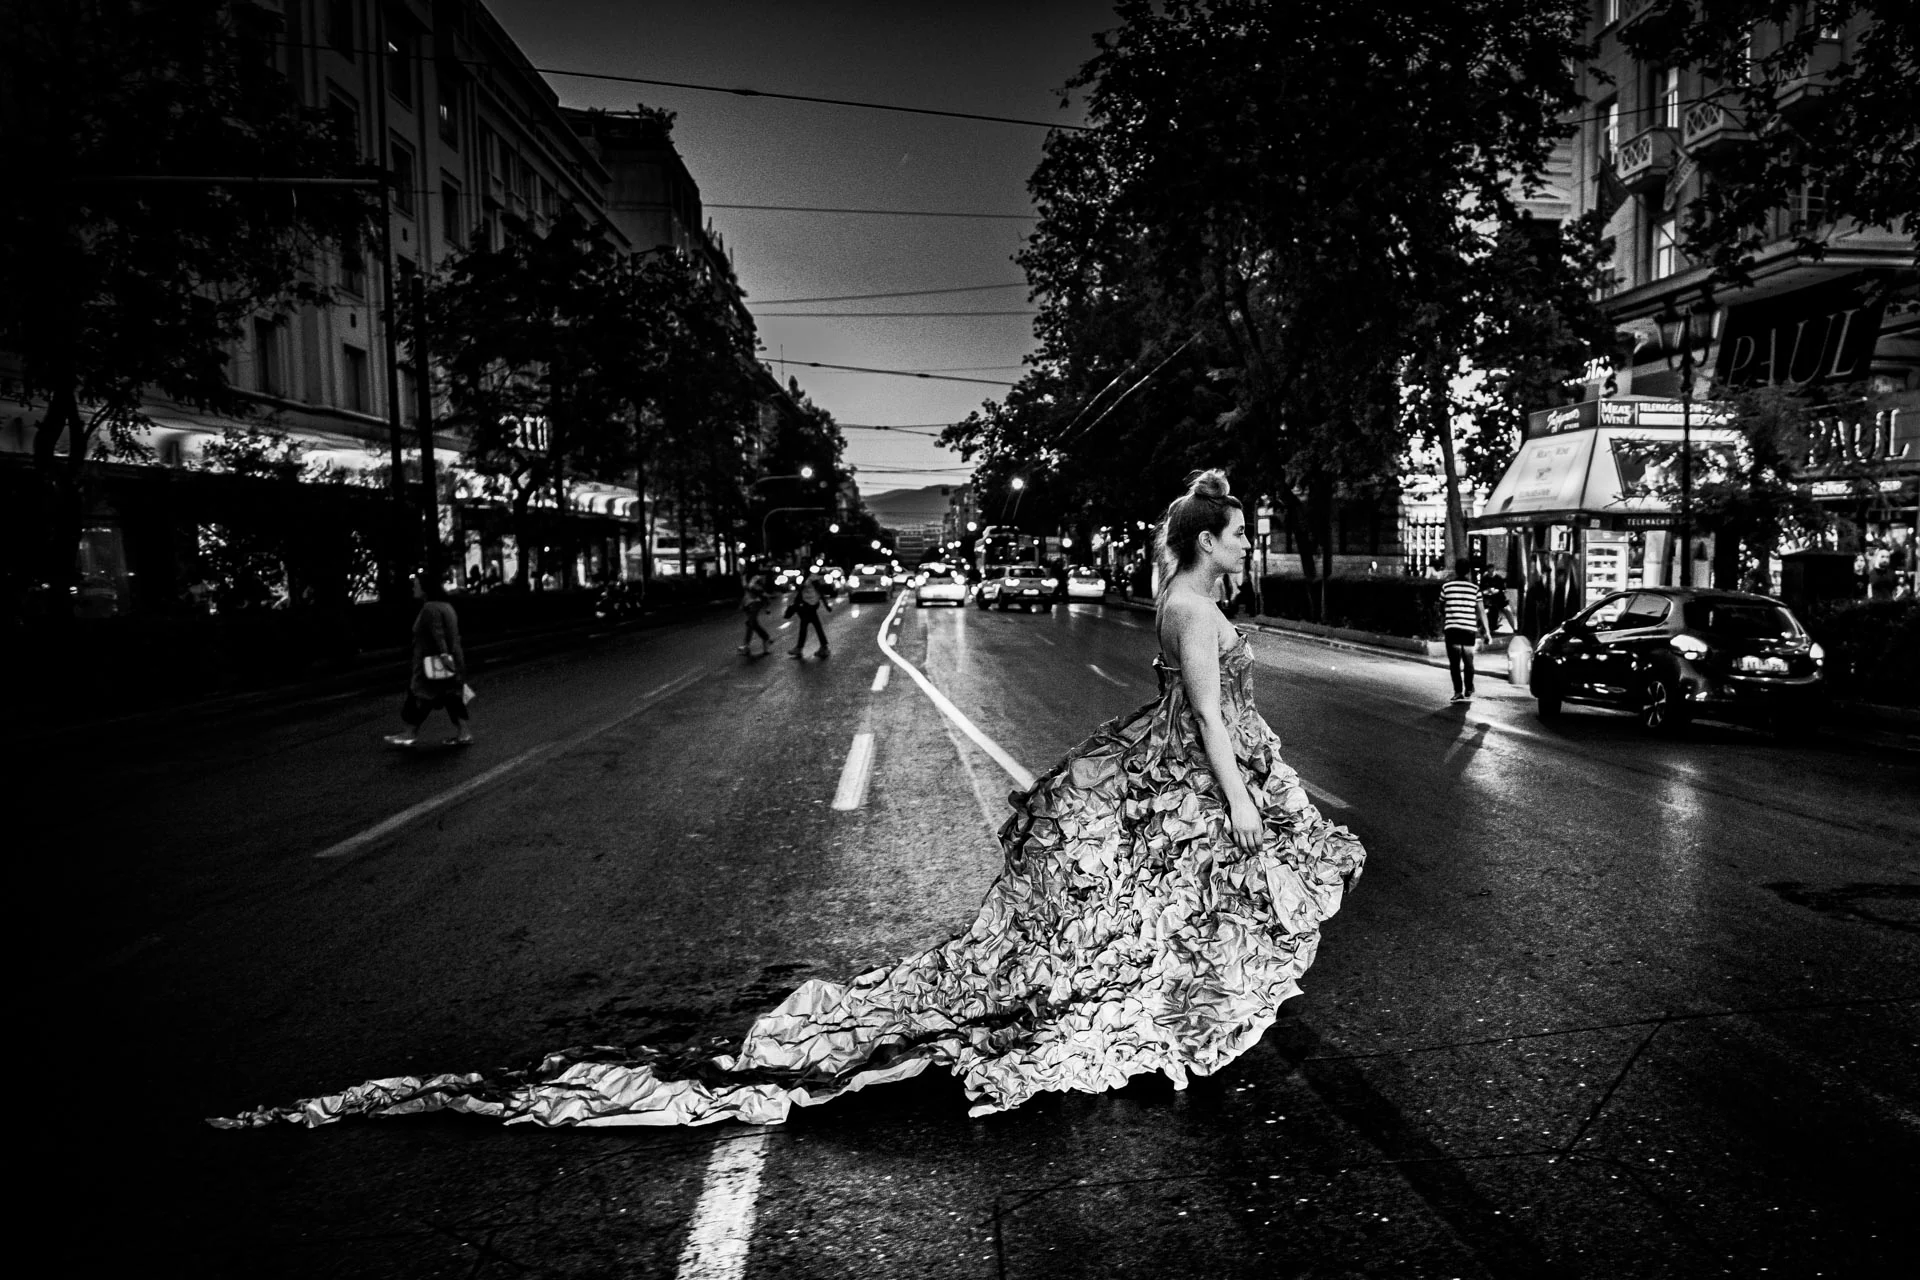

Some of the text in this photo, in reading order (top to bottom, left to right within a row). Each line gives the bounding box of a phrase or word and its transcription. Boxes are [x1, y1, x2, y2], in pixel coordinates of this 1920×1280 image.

[1727, 308, 1860, 388] PAUL
[1601, 402, 1630, 413] MEAT
[1601, 413, 1630, 425] WINE
[1804, 408, 1909, 468] PAUL
